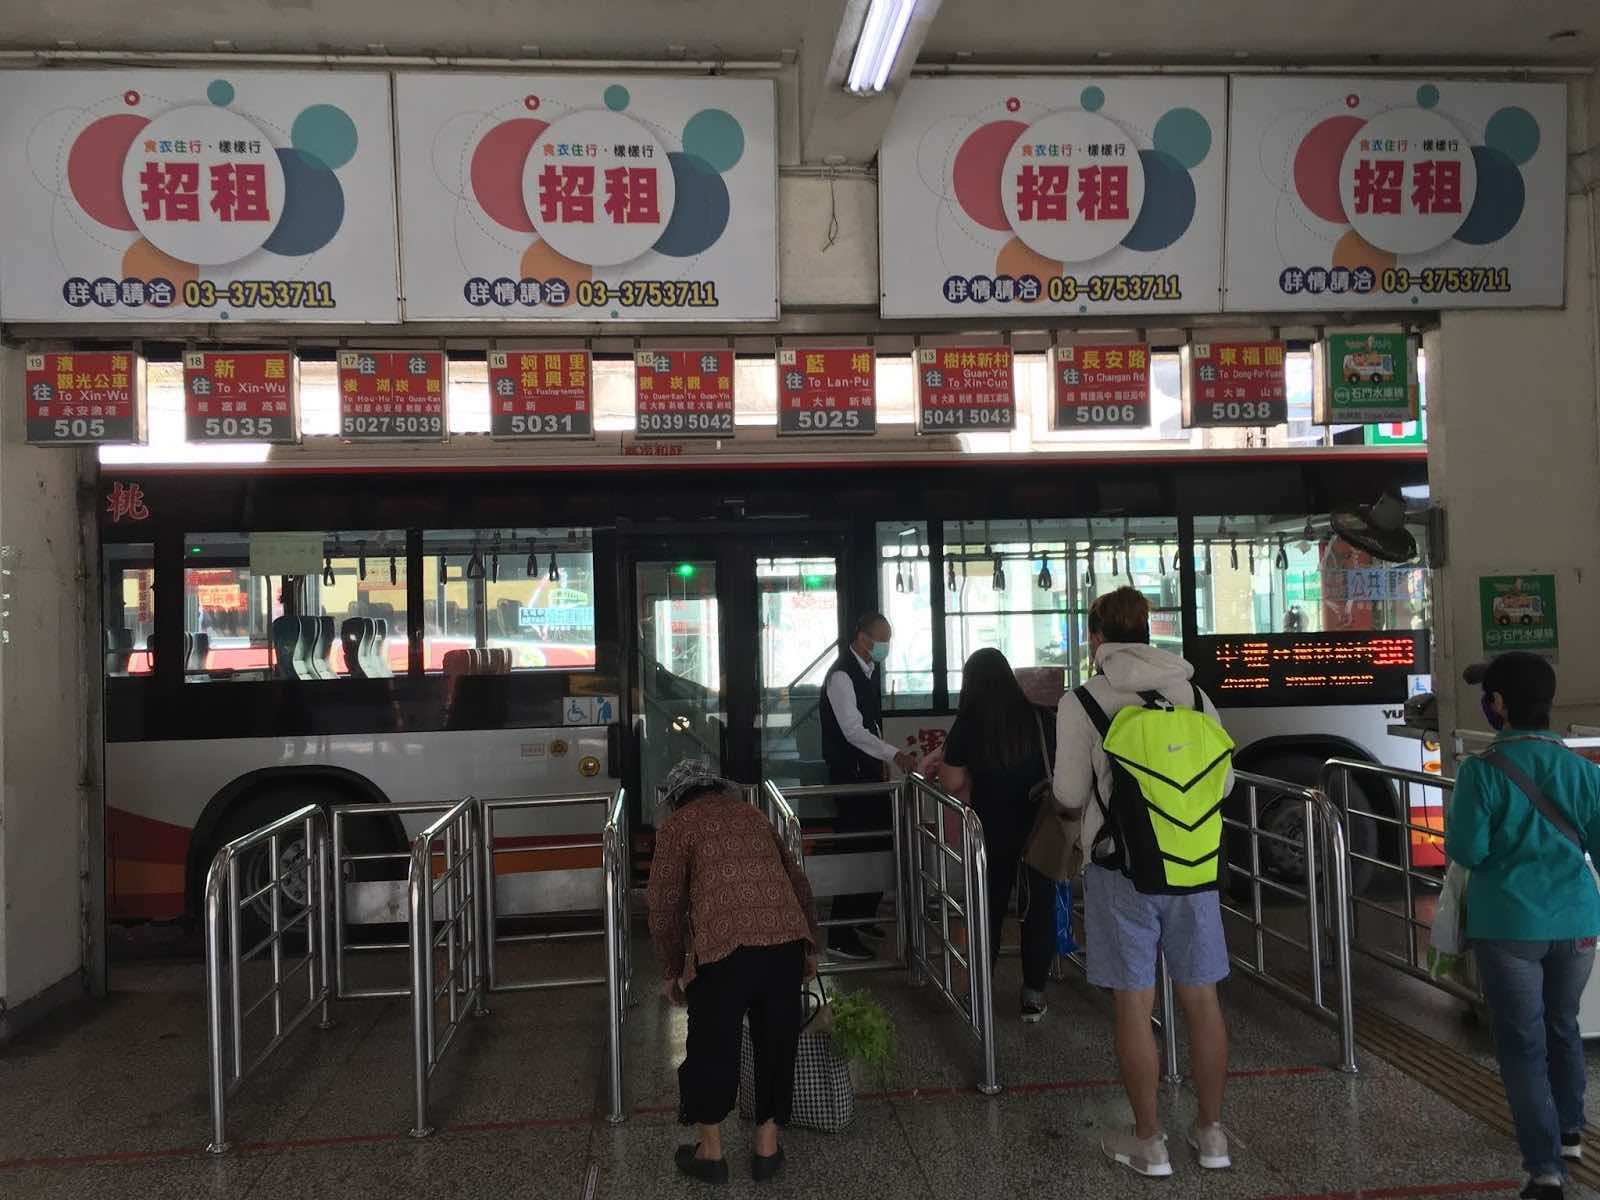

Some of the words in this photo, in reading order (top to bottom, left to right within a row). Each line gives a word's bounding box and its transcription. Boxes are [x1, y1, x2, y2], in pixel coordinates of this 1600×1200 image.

[140, 162, 270, 221] 招租
[539, 165, 660, 223] 招租
[1017, 165, 1129, 221] 招租
[1354, 160, 1462, 215] 招租
[947, 279, 1039, 300] 詳情請洽
[1048, 275, 1182, 301] 03-3753711
[1283, 271, 1373, 291] 詳情請洽
[1382, 268, 1511, 293] 03-3753711
[67, 281, 172, 305] 詳情請洽
[183, 280, 336, 308] 03-3753711
[469, 281, 567, 304] 詳情請洽
[577, 280, 718, 307] 03-3753711
[640, 353, 652, 363] 15
[783, 353, 793, 362] 14
[922, 351, 934, 360] 13
[1061, 350, 1072, 359] 12
[1197, 345, 1207, 355] 11
[31, 358, 42, 368] 19
[191, 357, 202, 367] 18
[214, 358, 286, 378] 新屋
[344, 356, 355, 367] 17
[359, 357, 376, 374] 往
[409, 357, 427, 374] 往
[494, 356, 504, 365] 16
[654, 356, 670, 372] 往
[701, 356, 718, 372] 往
[944, 352, 1010, 368] 樹林新村
[1083, 351, 1145, 369] 長安路
[926, 371, 942, 387] 往
[963, 369, 1007, 378] Guan-Yin
[1064, 369, 1079, 384] 往
[1083, 373, 1094, 382] To
[1200, 365, 1215, 380] 往
[1220, 370, 1229, 378] To
[57, 373, 129, 389] 觀光公車
[192, 377, 211, 395] 往
[217, 383, 231, 393] To
[238, 383, 286, 393] Xin-Wu
[496, 378, 515, 395] 往
[786, 373, 803, 389] 往
[808, 377, 821, 387] To
[827, 377, 869, 387] Lan-Pu
[948, 378, 959, 388] To
[964, 378, 1007, 388] Xin-Cun
[33, 384, 52, 401] 往
[59, 391, 73, 401] To
[80, 391, 128, 401] Xin-Wu
[924, 410, 963, 424] 5041
[970, 409, 1010, 424] 5043
[1076, 405, 1135, 422] 5006
[1212, 402, 1271, 419] 5038
[205, 418, 272, 435] 5035
[344, 417, 390, 432] 5027
[396, 417, 440, 432] 5039
[512, 415, 572, 432] 5031
[640, 414, 683, 429] 5039
[689, 414, 731, 429] 5042
[798, 410, 859, 428] 5025
[54, 419, 105, 437] 505
[106, 482, 149, 523] 桃
